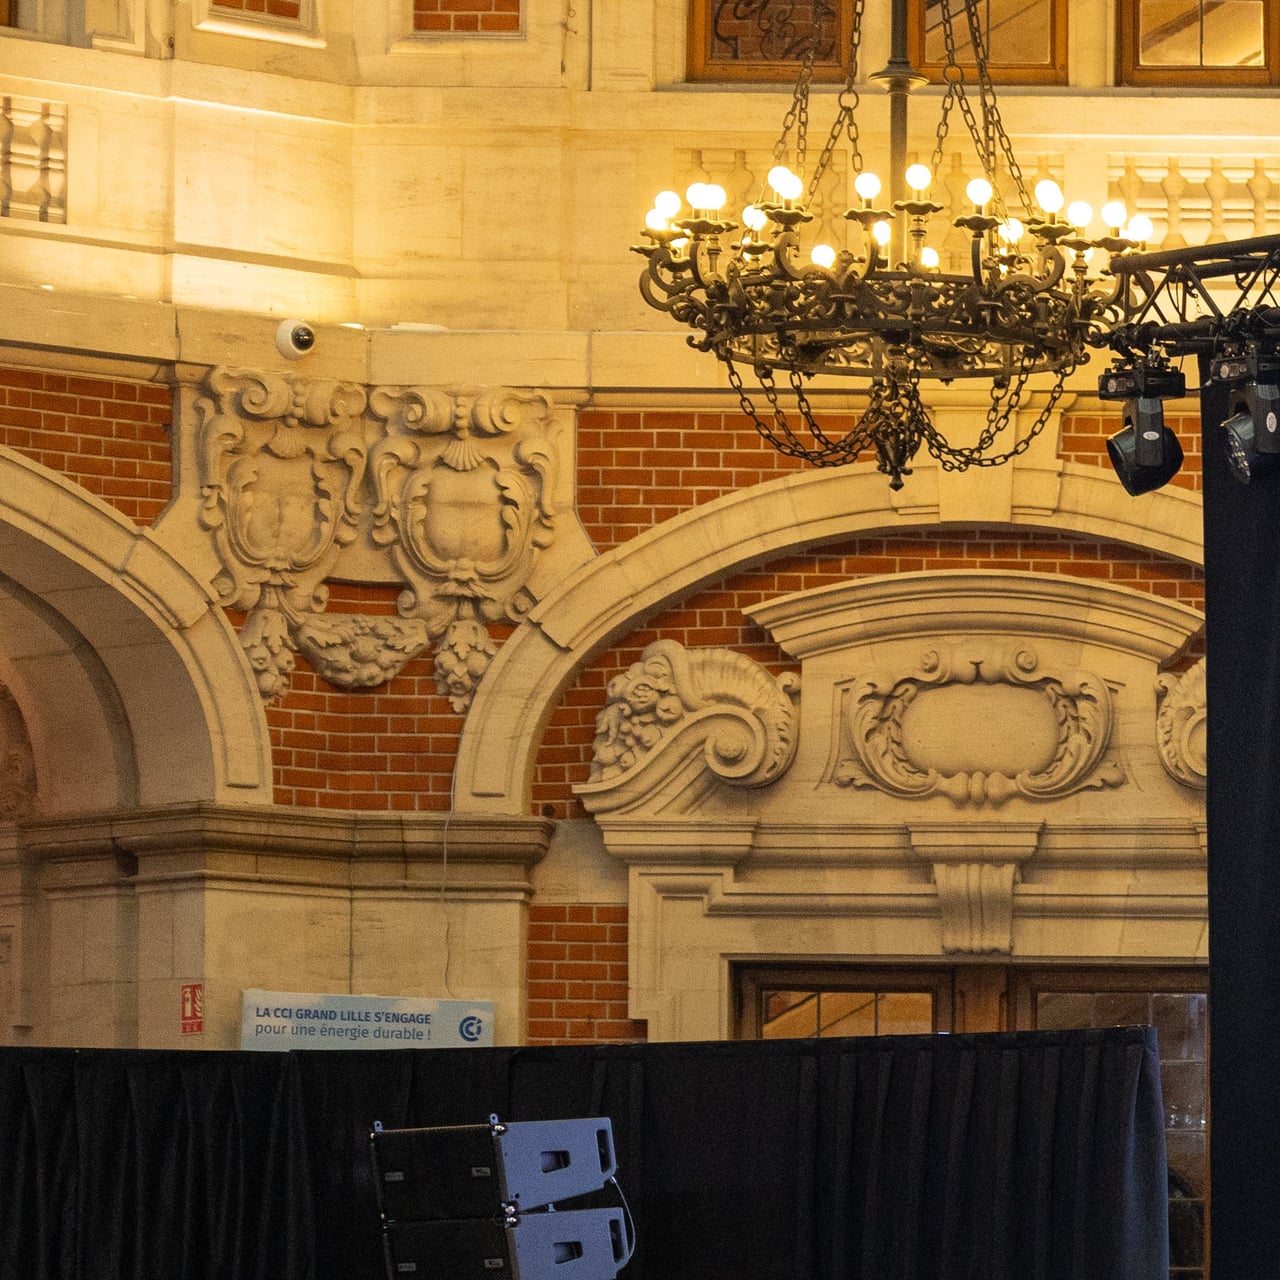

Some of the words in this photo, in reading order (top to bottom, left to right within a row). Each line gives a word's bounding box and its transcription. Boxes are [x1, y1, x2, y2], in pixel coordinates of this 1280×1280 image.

[255, 1006, 271, 1018] LA
[273, 1007, 292, 1019] CCI
[295, 1008, 337, 1021] GRAND
[340, 1010, 371, 1022] LILLE
[374, 1011, 432, 1025] S'ENGAGE
[255, 1024, 288, 1037] pour
[291, 1025, 316, 1036] une
[373, 1026, 424, 1040] durable
